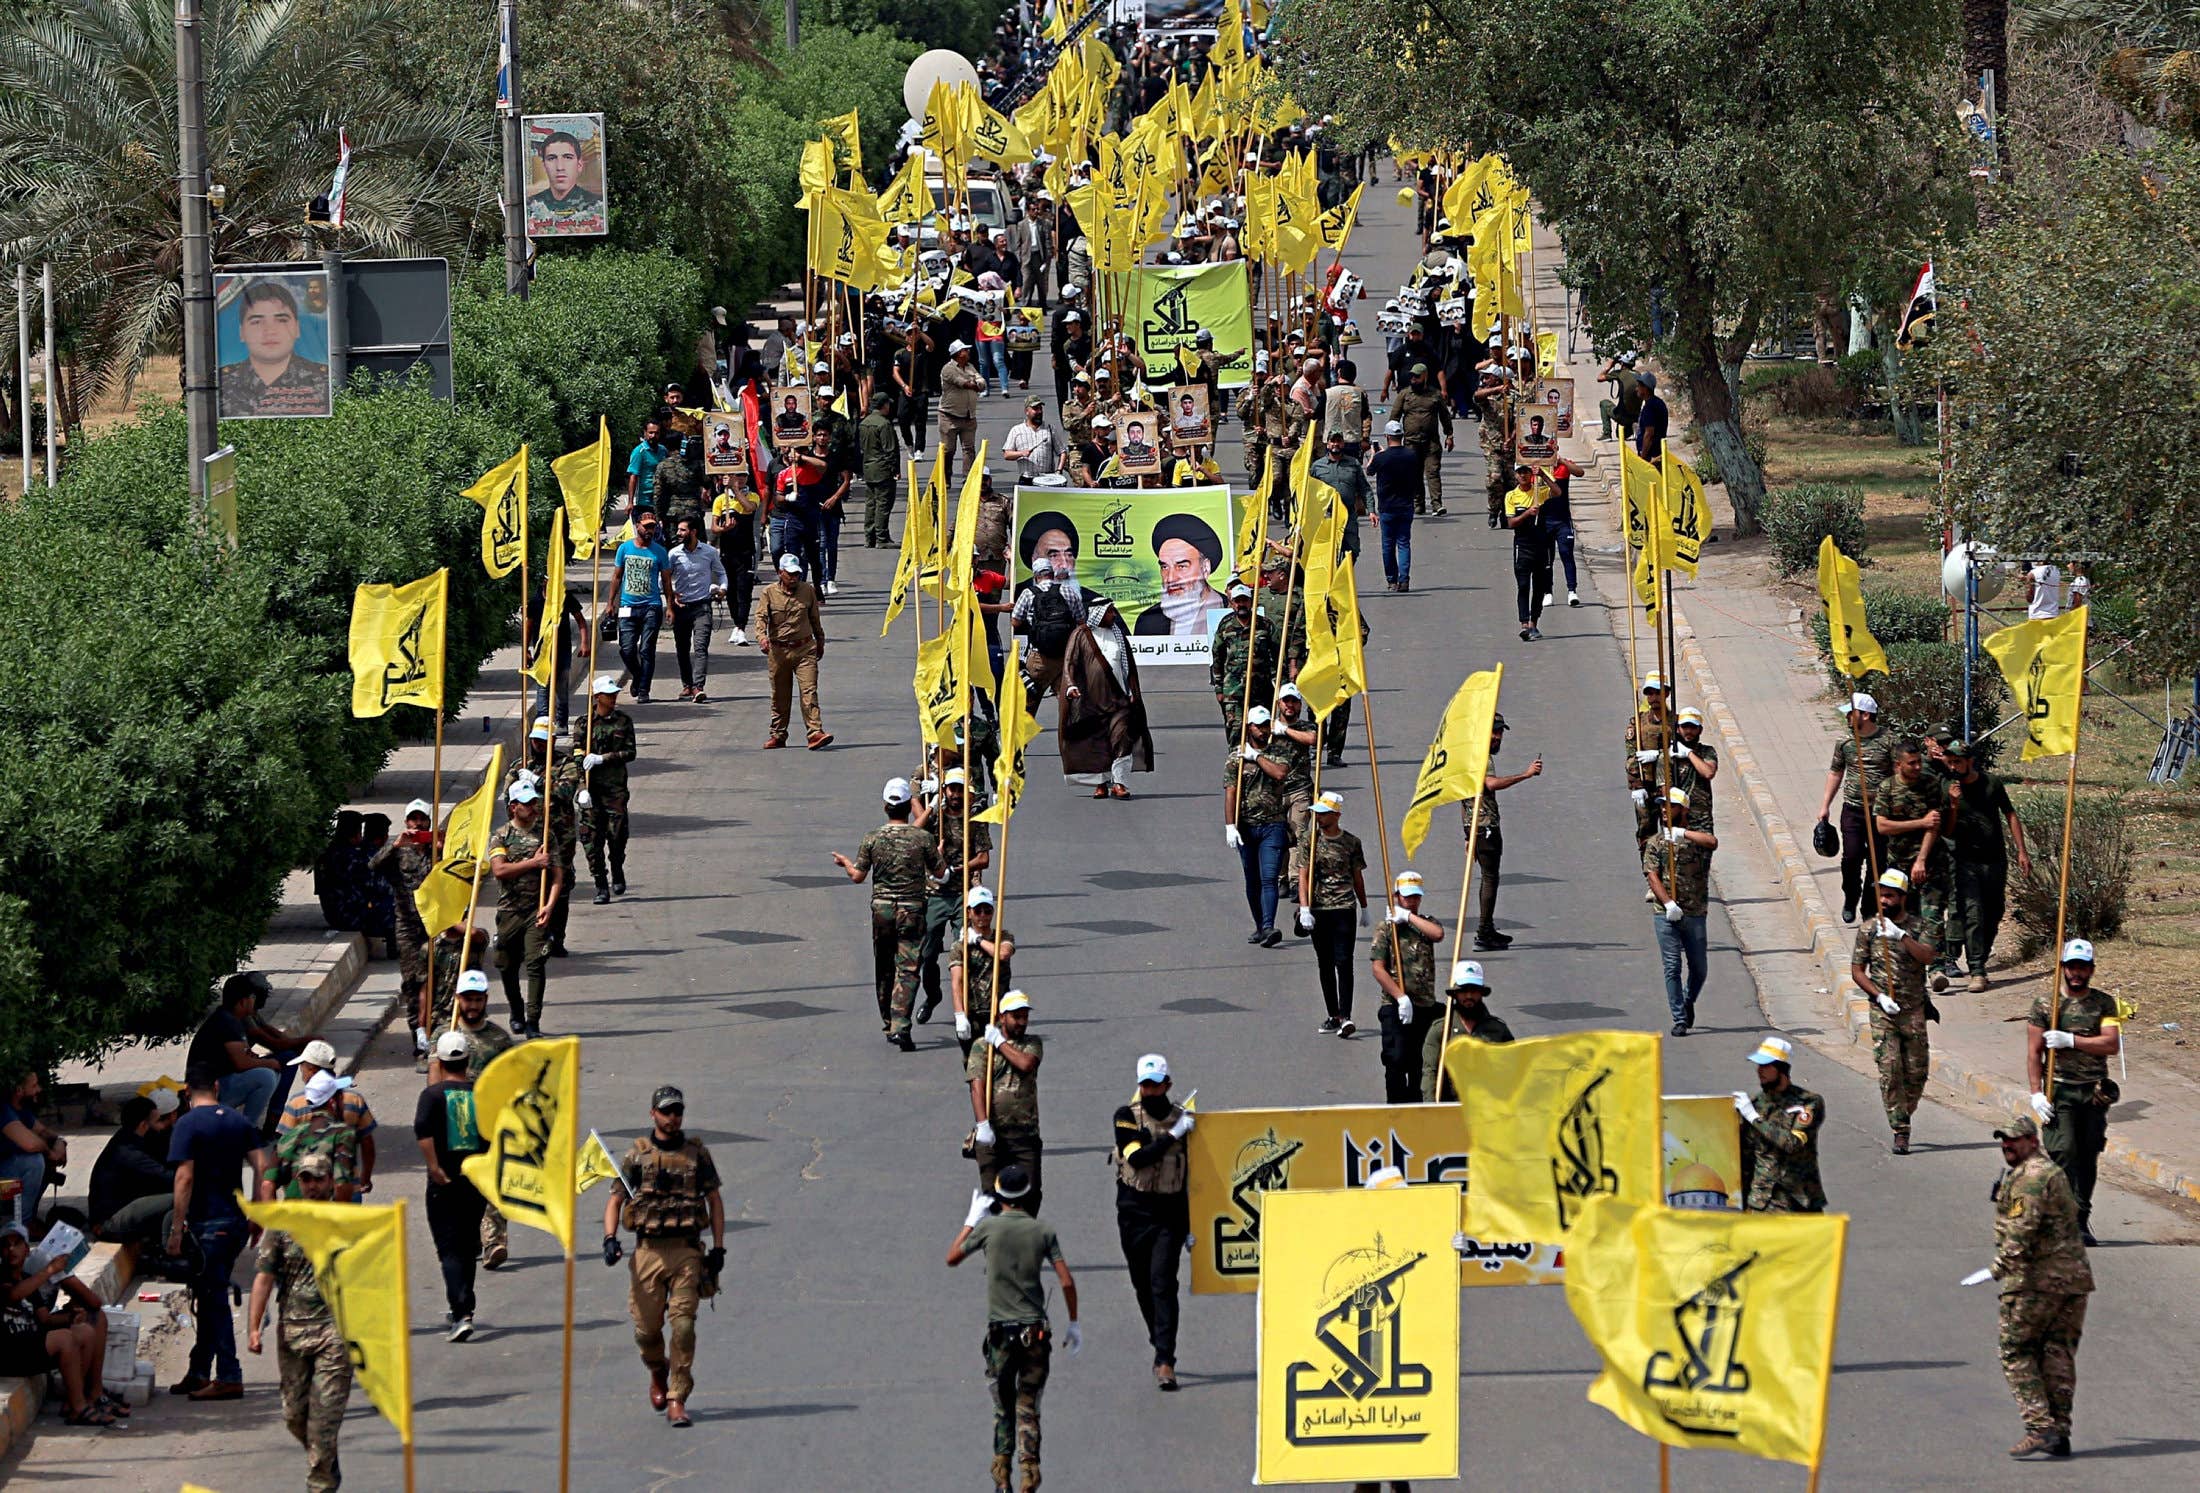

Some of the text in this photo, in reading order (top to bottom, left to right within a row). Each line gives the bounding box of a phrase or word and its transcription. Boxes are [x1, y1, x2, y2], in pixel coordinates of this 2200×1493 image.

[1131, 640, 1210, 656] مثلية الرصاف
[1302, 1405, 1421, 1436] سرايا الخراساني
